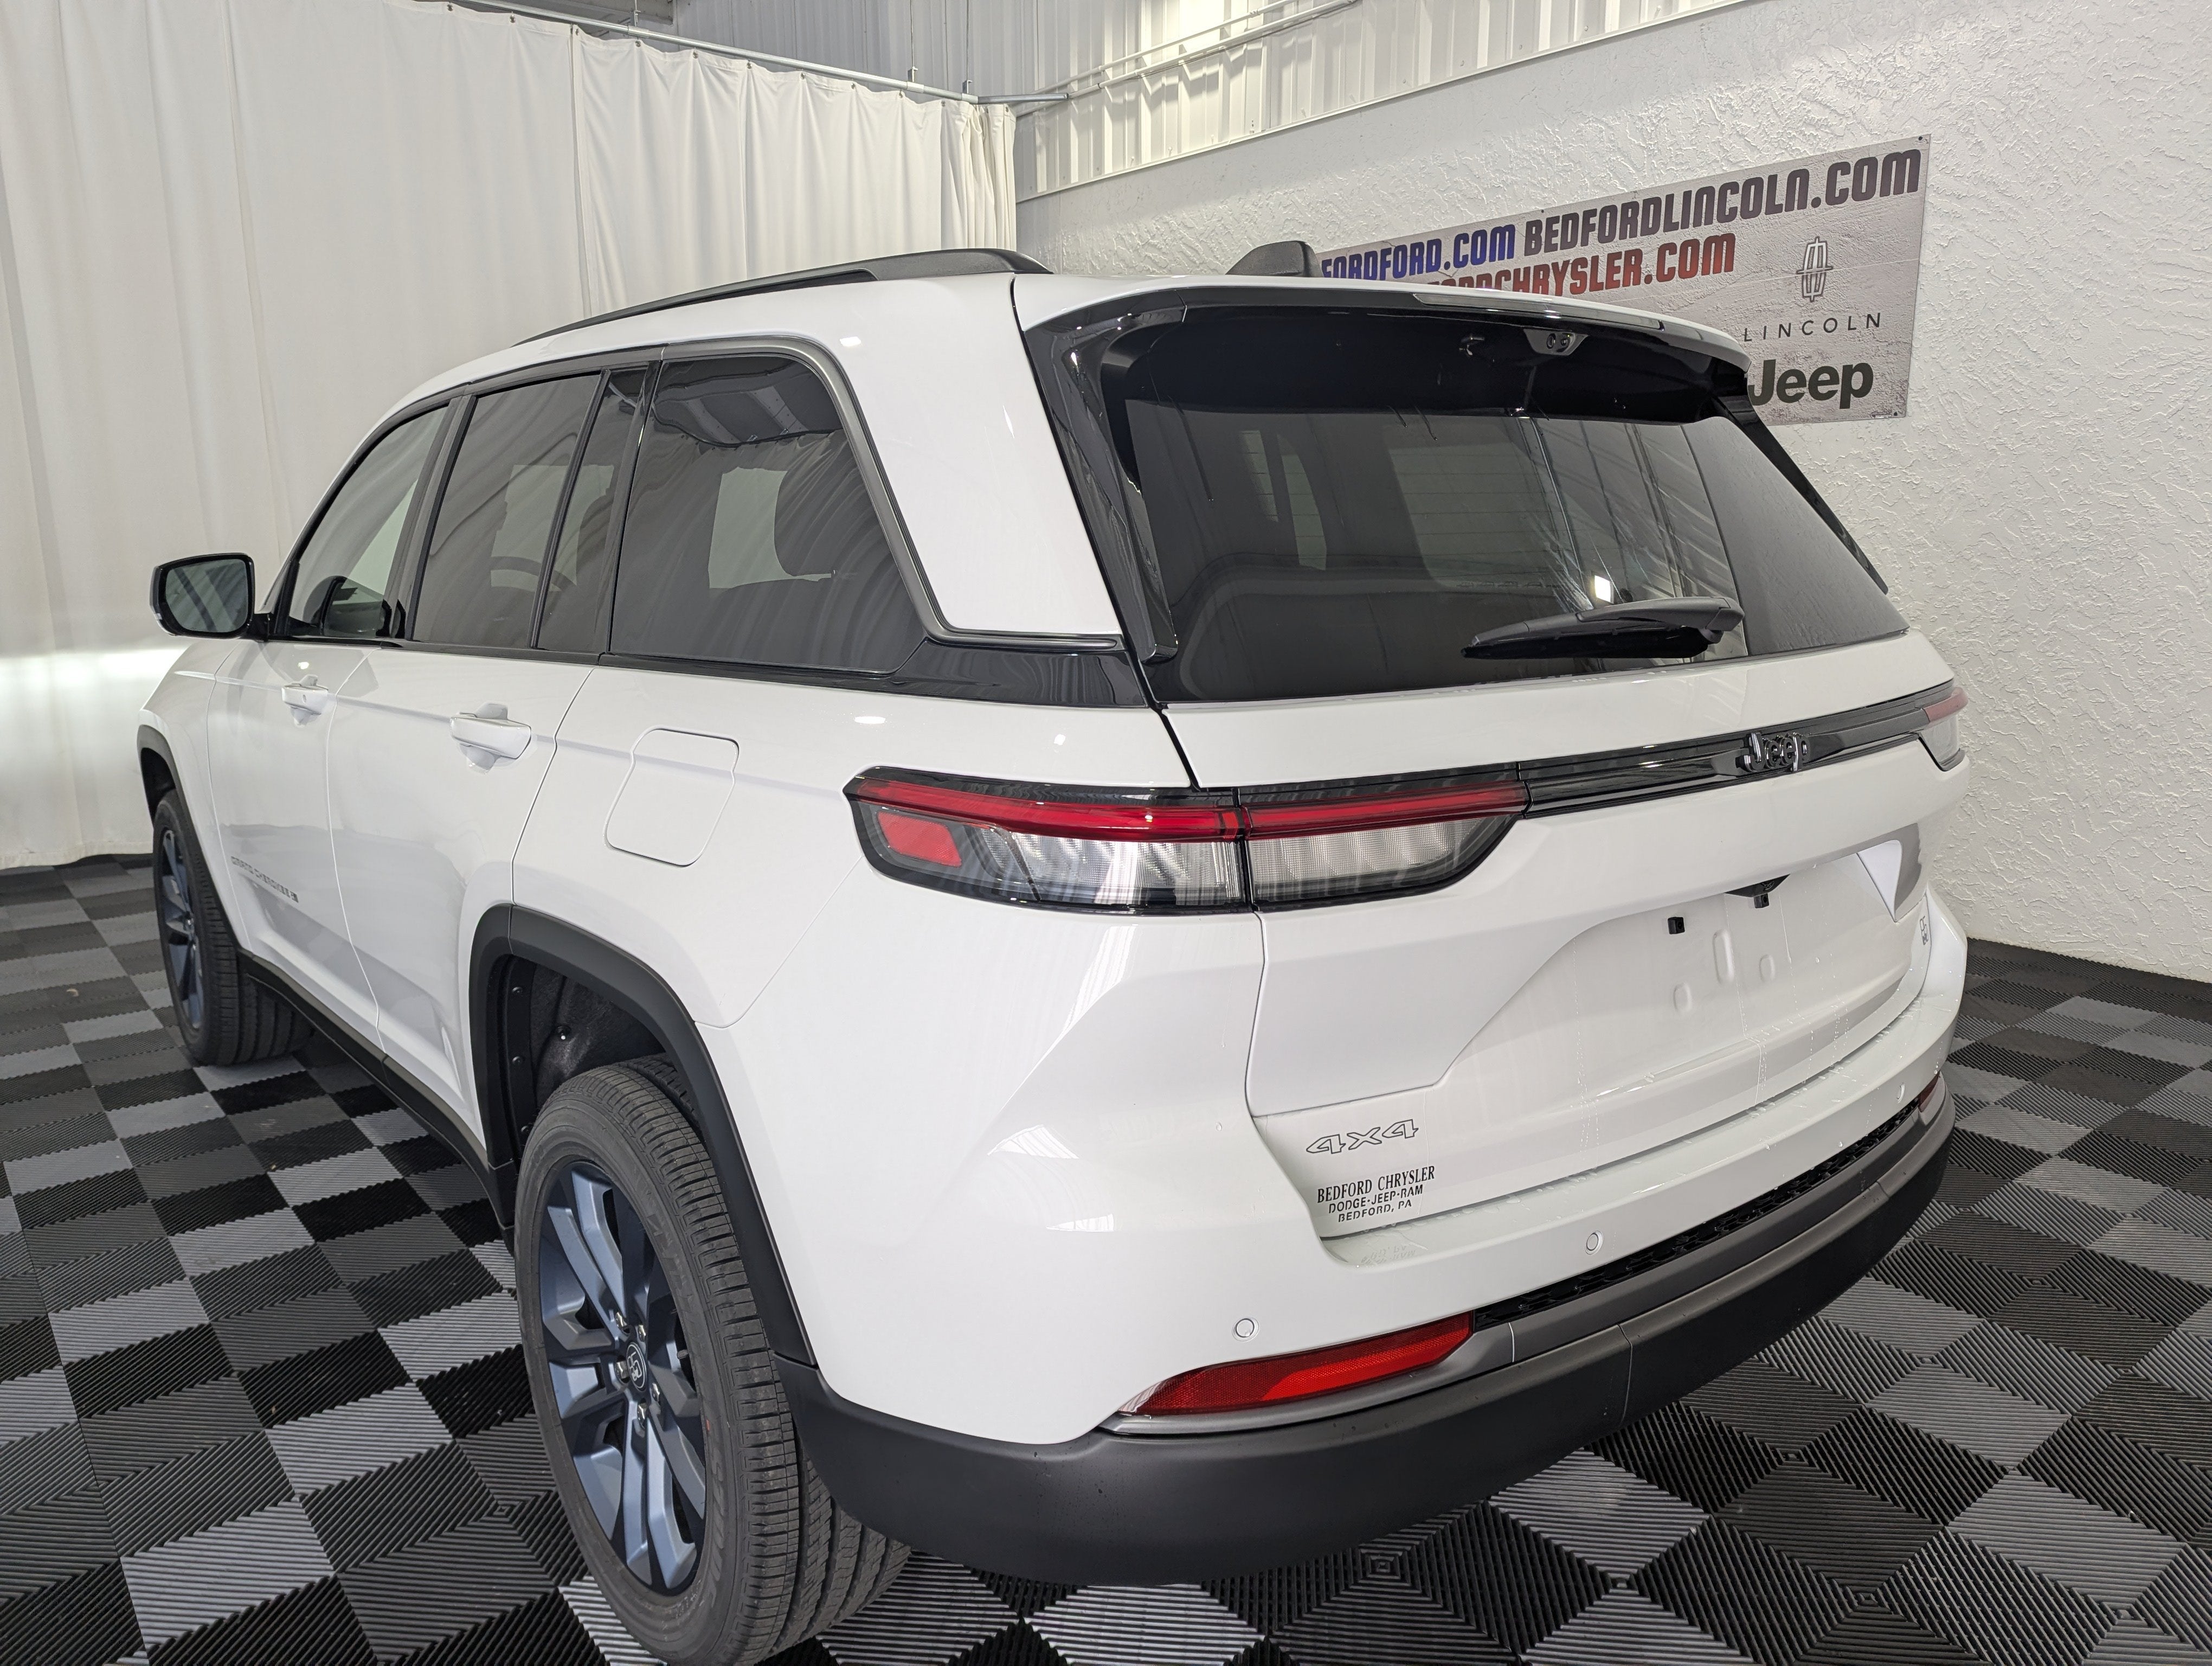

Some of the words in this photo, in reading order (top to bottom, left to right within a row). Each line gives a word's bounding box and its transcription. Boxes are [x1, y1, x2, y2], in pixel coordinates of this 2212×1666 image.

[1523, 148, 1921, 257] BEDFORDLINCOLN.COM
[1427, 232, 1736, 297] CHRYSLER.COM
[1744, 312, 1881, 342] LINCOLN
[1747, 358, 1874, 409] Jeep
[1737, 732, 1810, 772] Jeep
[1317, 1179, 1372, 1203] BEDFORD
[1378, 1165, 1435, 1191] CHRYSLER
[1338, 1203, 1394, 1222] BEDFORD,
[1398, 1199, 1412, 1210] PA
